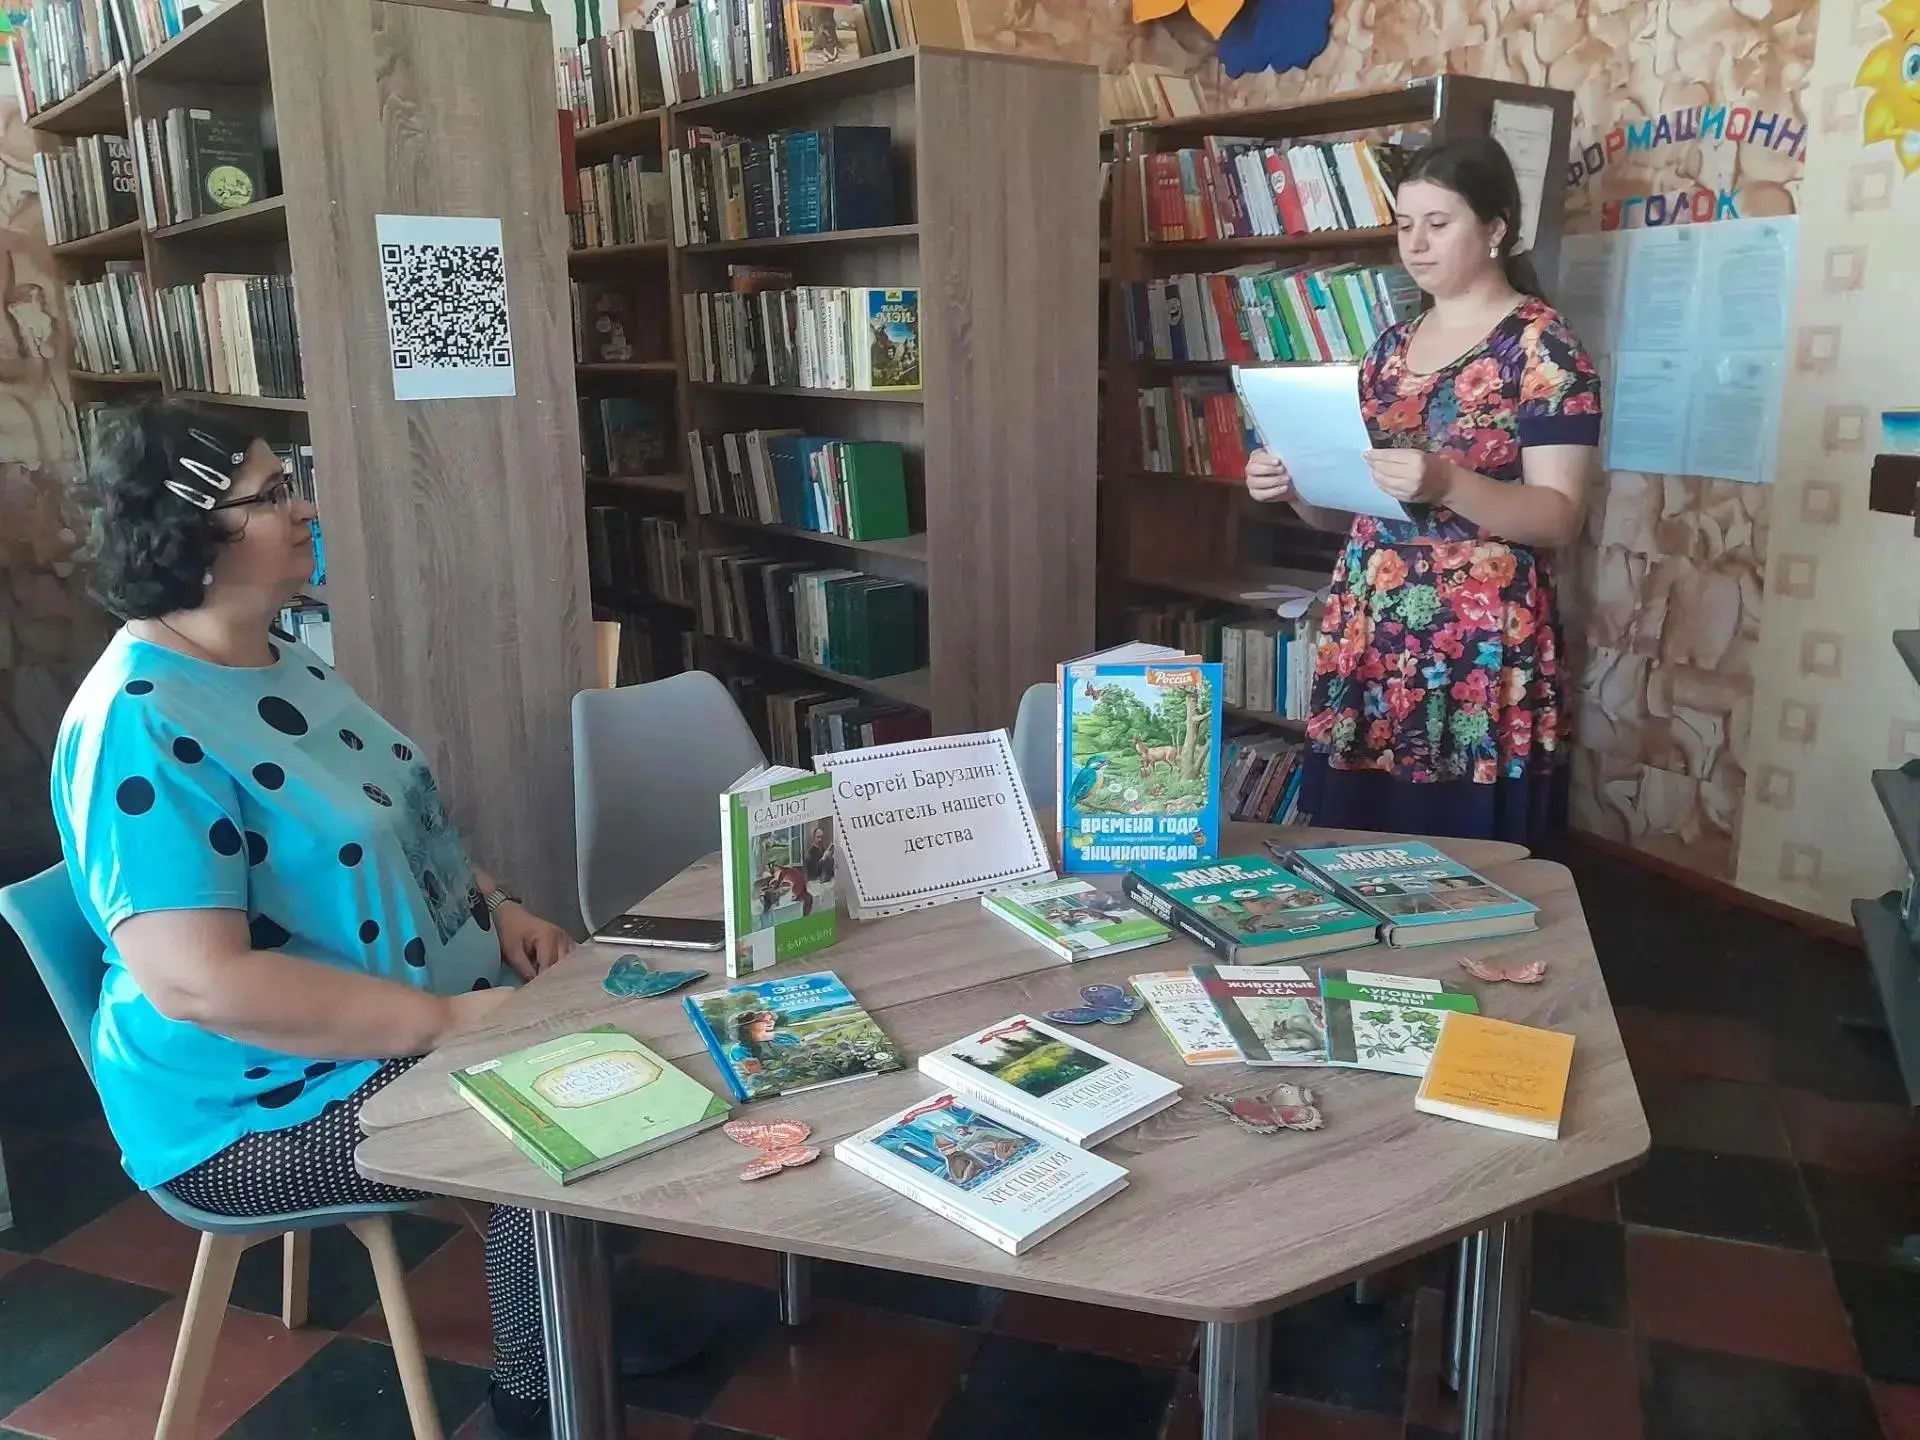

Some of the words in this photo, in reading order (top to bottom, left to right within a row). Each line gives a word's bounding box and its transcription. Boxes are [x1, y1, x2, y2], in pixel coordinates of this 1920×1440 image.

[1566, 104, 1807, 187] ФОРМАЦИОНН
[111, 160, 120, 174] Я
[1602, 188, 1741, 231] УГОЛОК
[874, 310, 916, 324] МЭЙ
[880, 304, 908, 313] КАРЛ
[1155, 671, 1194, 685] Россия
[838, 773, 908, 801] Сергей
[912, 762, 1002, 788] Баруздин:
[754, 798, 808, 823] САЛЮТ
[851, 802, 938, 830] писатель
[941, 791, 1006, 815] нашего
[1080, 817, 1154, 834] ВРЕМЕНА
[904, 828, 974, 855] детства
[1080, 845, 1198, 861] ЭНЦИКЛОПЕДИЯ
[1335, 849, 1409, 862] МИР
[1172, 864, 1242, 880] МИР
[1322, 855, 1447, 872] ЖИВОТНЫХ
[1160, 868, 1279, 890] ЖИВОТНЫХ
[771, 984, 810, 994] Это
[1226, 981, 1316, 989] ЖИВОТНЫЕ
[756, 986, 834, 1005] Родина
[1358, 987, 1435, 1001] ЛУГОВЫЕ
[1371, 994, 1424, 1005] ТРАВЫ
[1051, 1068, 1135, 1111] ХРЕСТОМАТИЯ
[982, 1151, 1073, 1206] ХРЕСТОМАТИЯ
[1016, 1192, 1035, 1203] ПО
[1036, 1169, 1071, 1193] ЧТЕНИЮ
